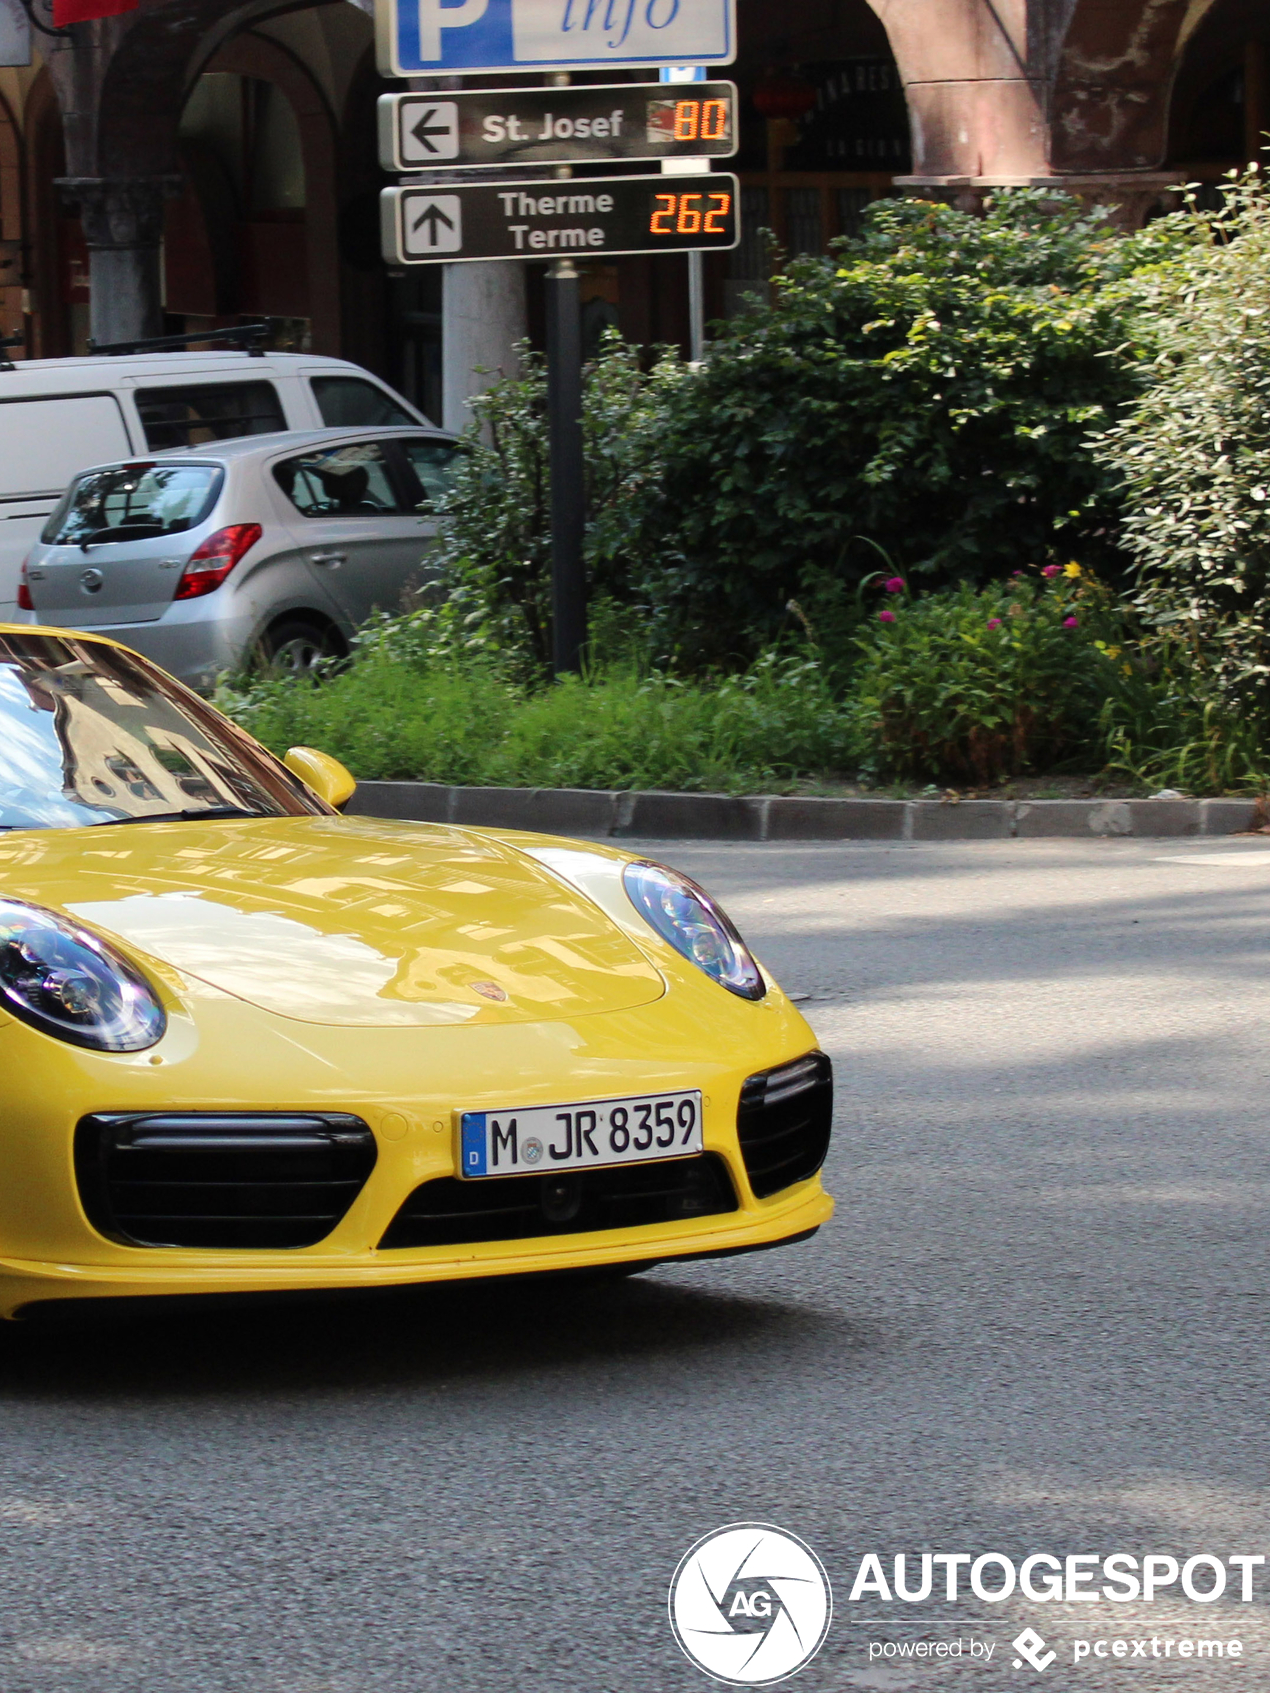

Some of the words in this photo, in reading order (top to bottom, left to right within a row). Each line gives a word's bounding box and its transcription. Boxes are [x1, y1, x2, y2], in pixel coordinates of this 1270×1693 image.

[419, 0, 487, 61] P
[482, 114, 529, 143] St.
[538, 109, 623, 141] Josef
[673, 100, 726, 140] 80
[498, 191, 614, 217] Therme
[650, 193, 730, 234] 262
[508, 225, 605, 250] Terme
[469, 1151, 479, 1165] D
[491, 1118, 518, 1166] M
[548, 1110, 599, 1160] JR
[609, 1098, 696, 1153] 8359
